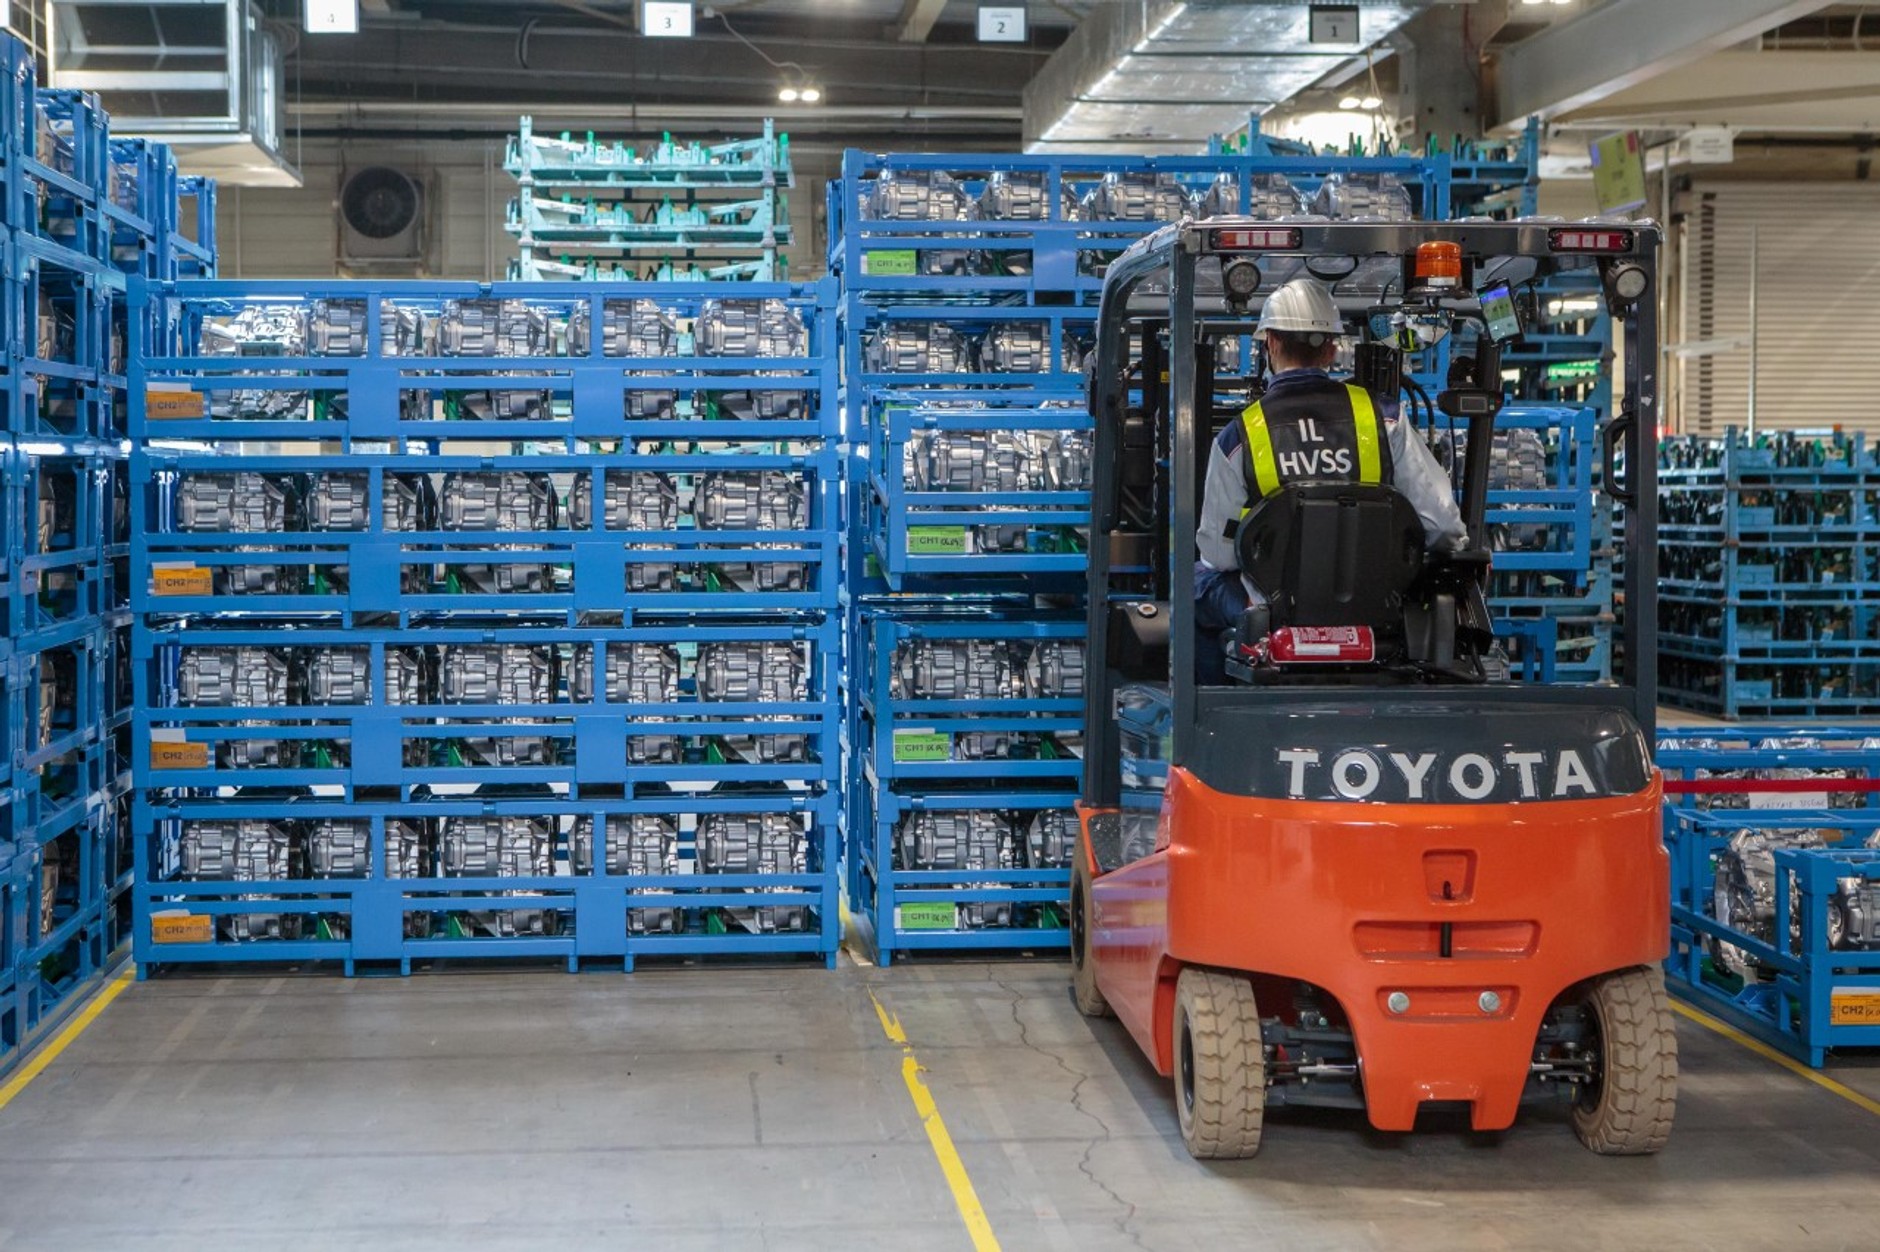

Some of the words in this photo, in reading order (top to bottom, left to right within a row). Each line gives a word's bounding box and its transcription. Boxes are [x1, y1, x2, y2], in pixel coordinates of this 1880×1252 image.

[664, 16, 672, 29] 3
[997, 21, 1006, 34] 2
[1331, 24, 1338, 37] 1
[157, 400, 178, 410] CH2
[1298, 418, 1324, 442] IL
[1278, 448, 1353, 476] HVSS
[919, 535, 939, 545] CH1
[166, 577, 186, 587] CH2
[904, 743, 925, 752] CH1
[162, 751, 184, 760] CH2
[1278, 750, 1597, 799] TOYOTA
[910, 912, 931, 920] CH1
[164, 925, 185, 934] CH2
[1841, 1005, 1865, 1015] CH2
